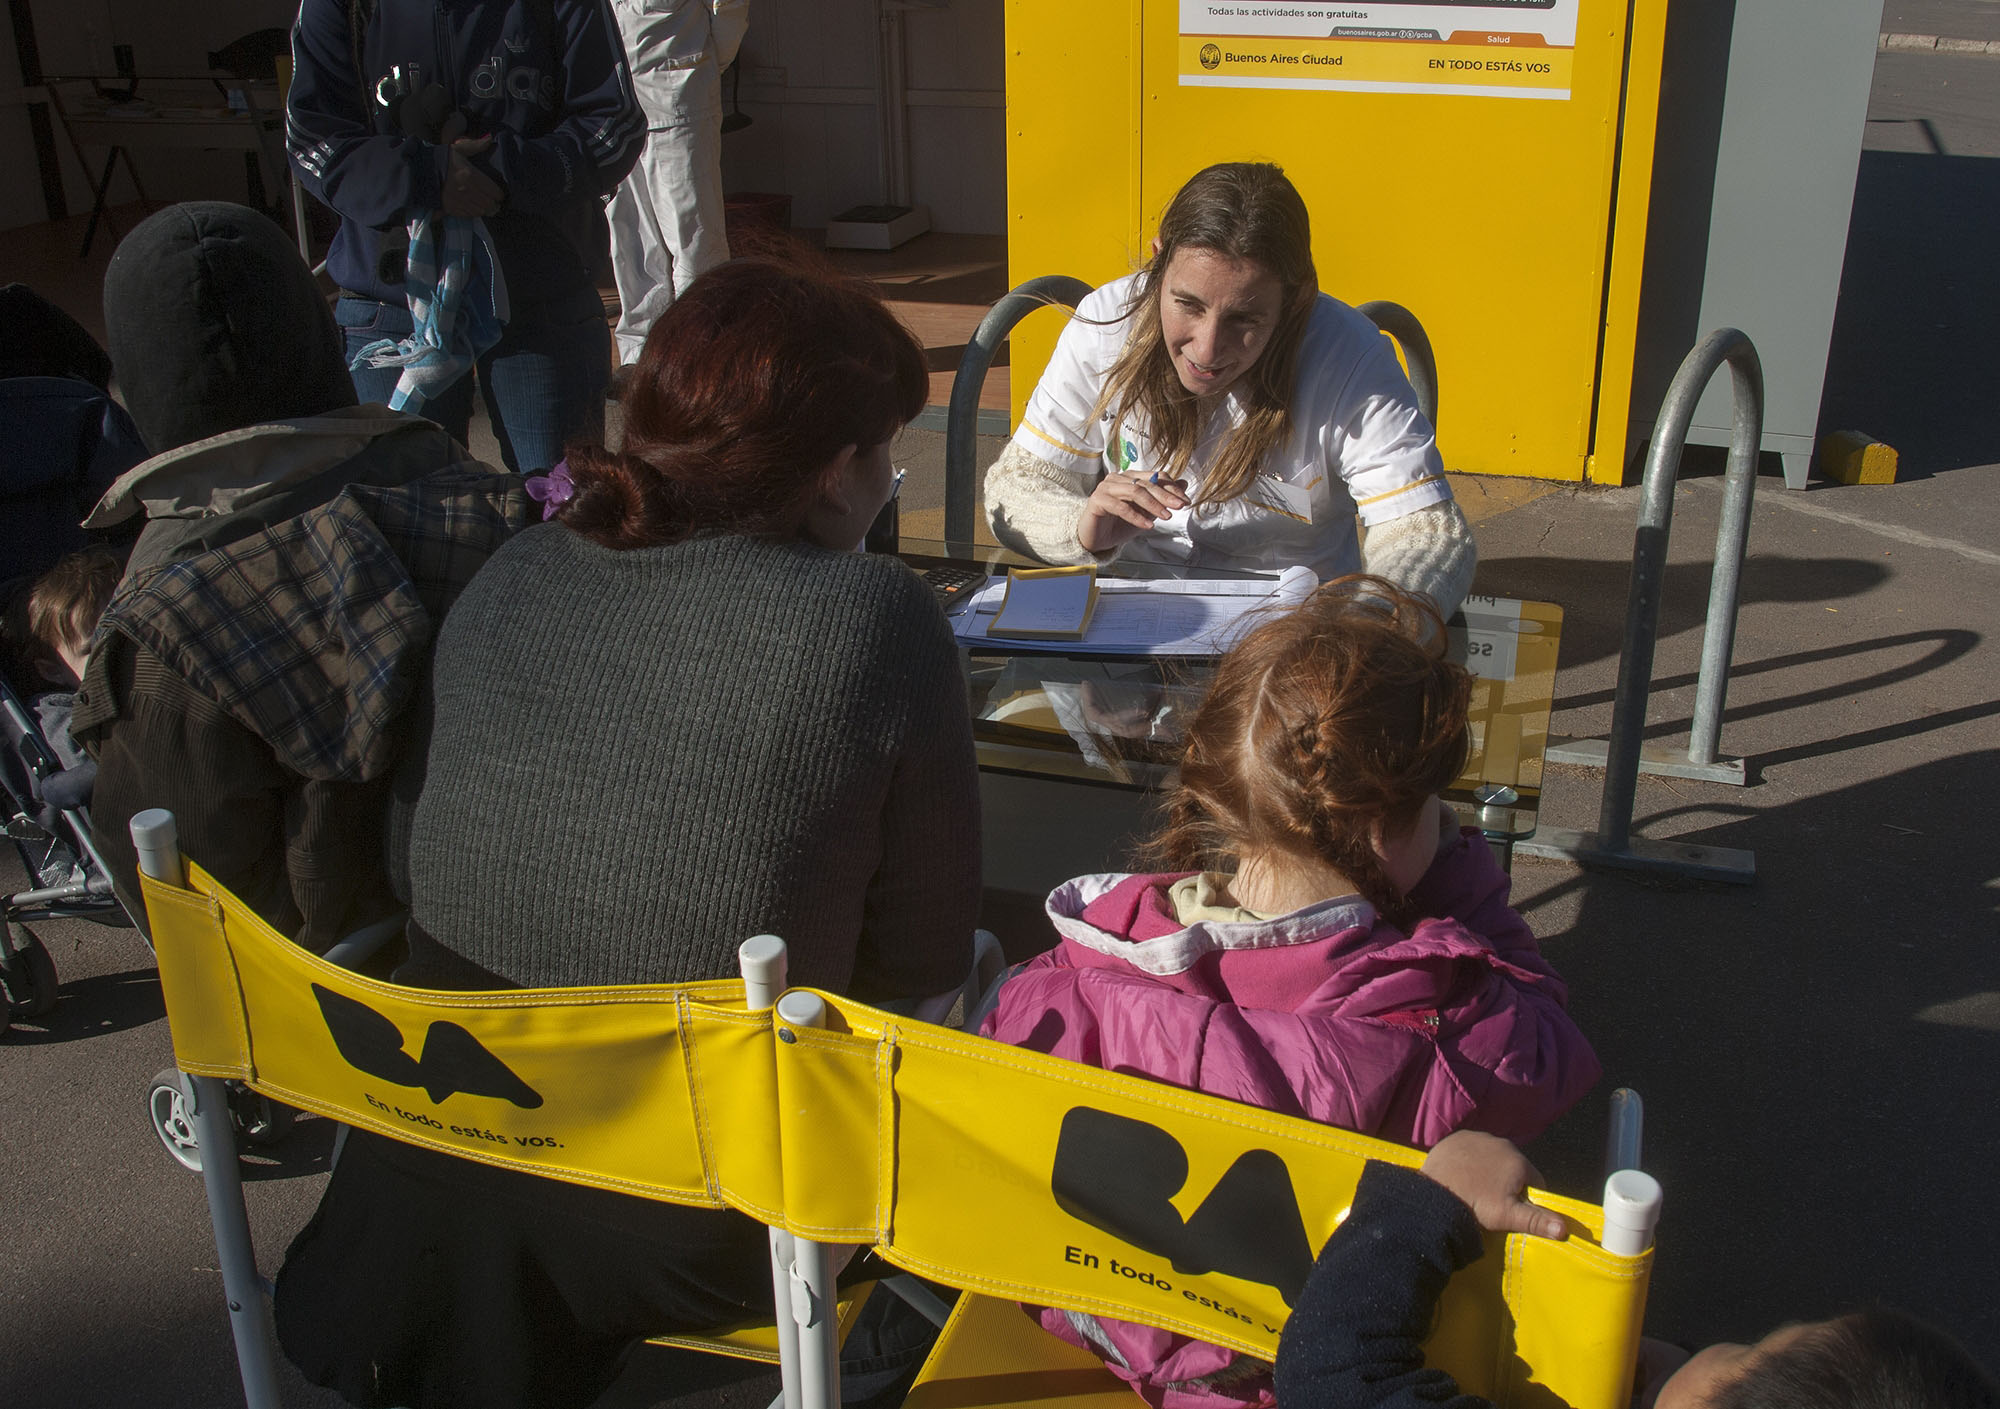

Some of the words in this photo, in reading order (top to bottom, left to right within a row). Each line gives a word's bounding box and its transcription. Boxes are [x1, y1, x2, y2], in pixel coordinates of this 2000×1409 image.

[1207, 7, 1234, 16] Todas
[1236, 7, 1249, 16] las
[1251, 8, 1305, 17] actividades
[1307, 10, 1324, 18] son
[1326, 10, 1368, 20] gratuitas
[1338, 29, 1398, 38] buenosaires.gob.ar
[1487, 34, 1510, 45] Salud
[1225, 52, 1268, 64] Buenos
[1270, 53, 1299, 65] Aires
[1302, 54, 1343, 66] Ciudad
[1428, 59, 1445, 69] EN
[1448, 60, 1483, 71] TODO
[1485, 58, 1523, 73] ESTÁS
[1525, 62, 1551, 74] VOS
[364, 1092, 390, 1114] En
[394, 1104, 444, 1130] todo
[450, 1123, 508, 1145] estás
[514, 1135, 565, 1148] vos.
[1051, 1105, 1315, 1310] BA
[1064, 1245, 1099, 1269] En
[1109, 1258, 1172, 1292] todo
[1182, 1287, 1253, 1325] estás
